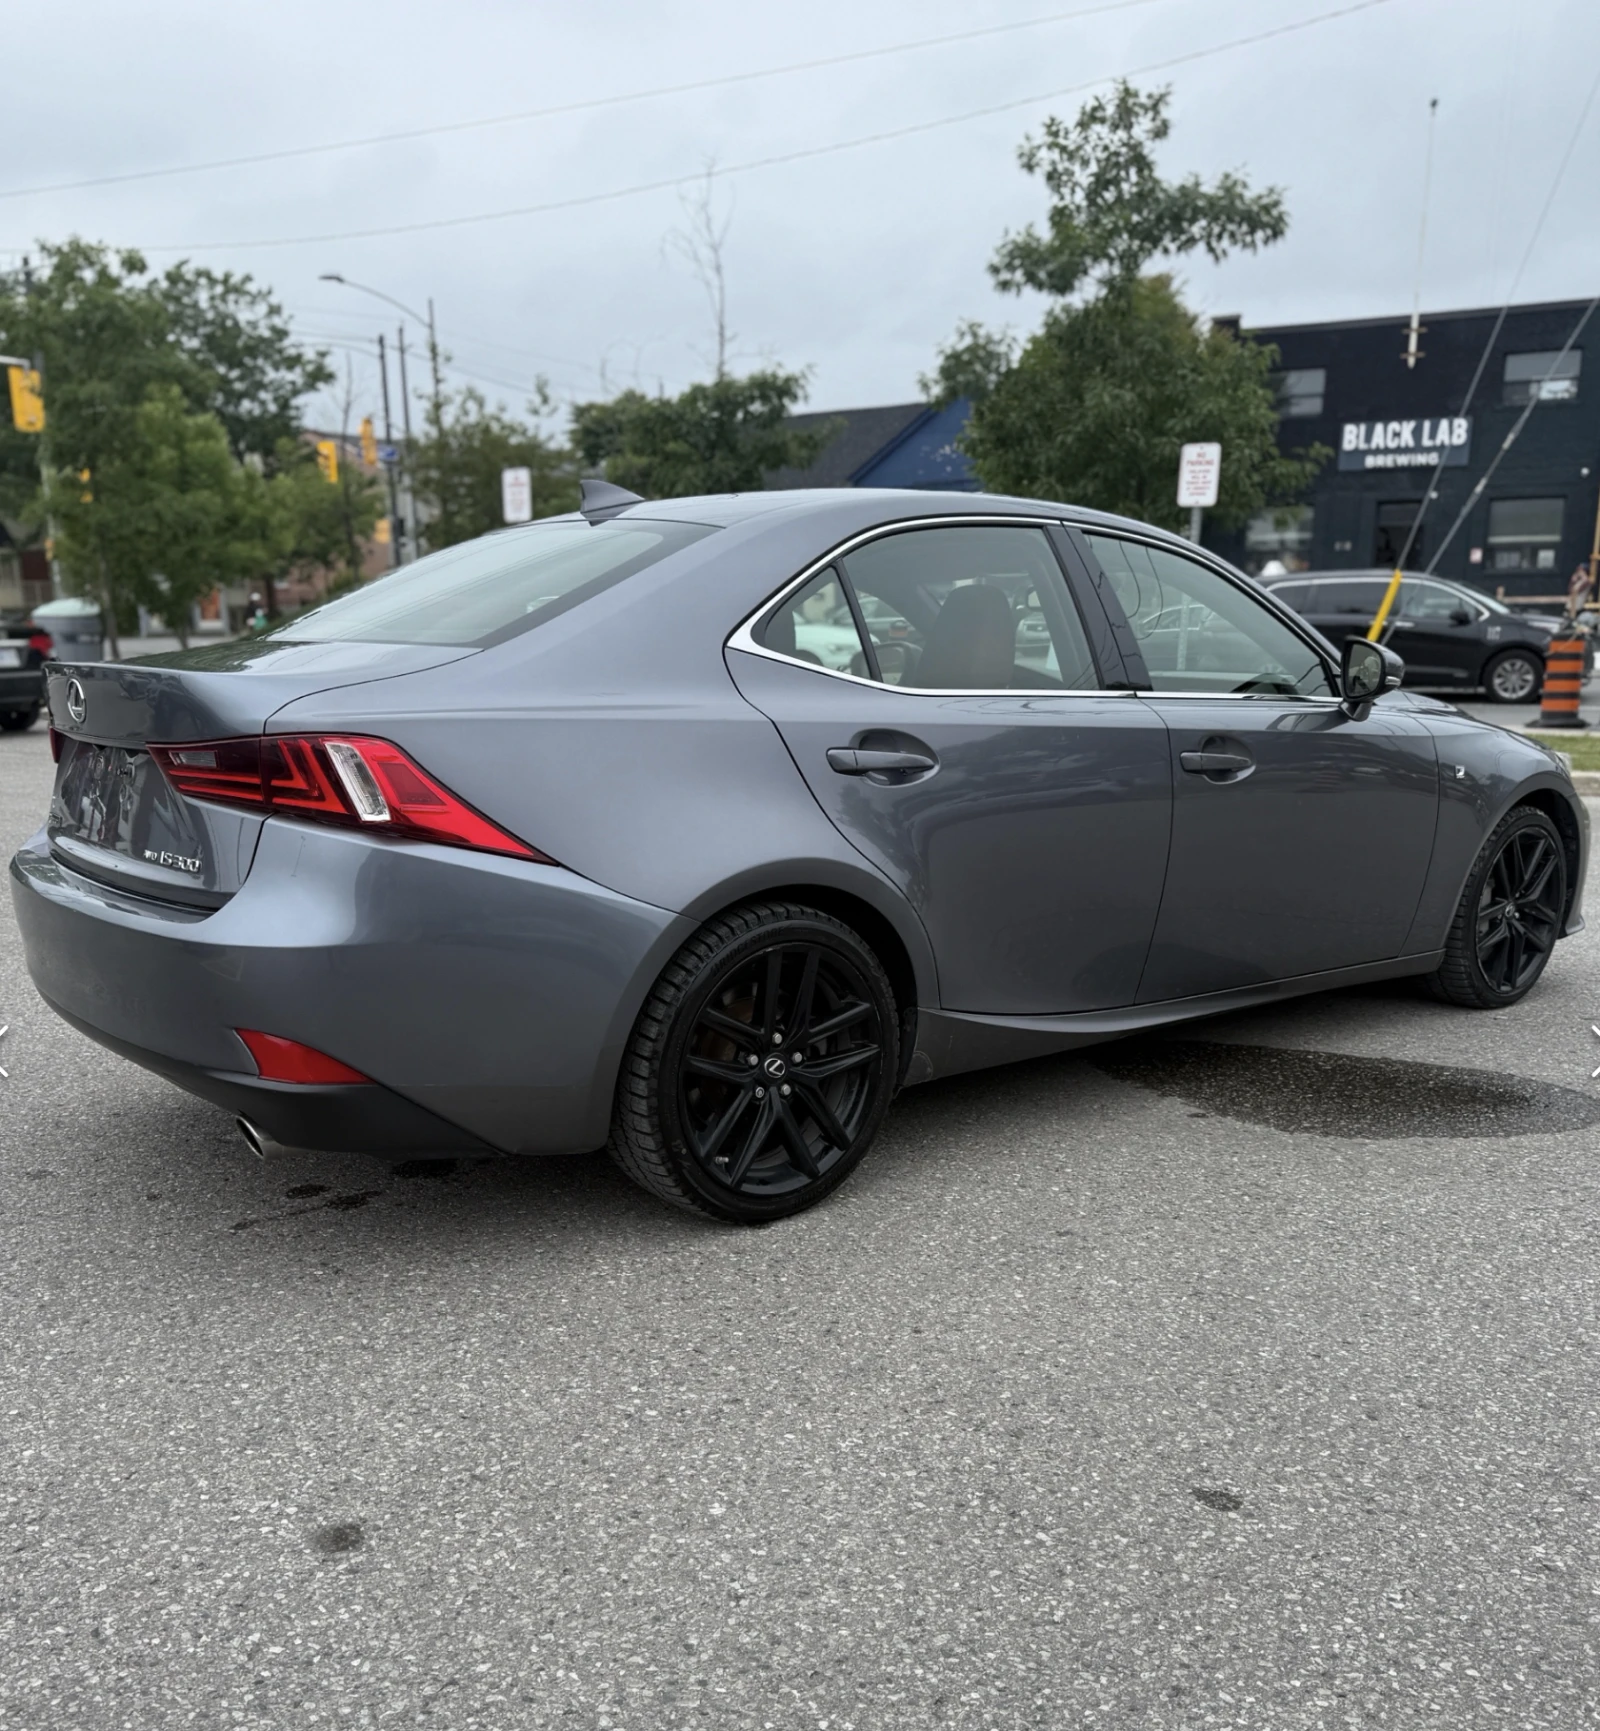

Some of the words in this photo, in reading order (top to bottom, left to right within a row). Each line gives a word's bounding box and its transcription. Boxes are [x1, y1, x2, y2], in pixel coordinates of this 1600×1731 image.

[1342, 420, 1416, 451] BLACK
[1421, 418, 1468, 447] LAB
[1364, 452, 1440, 469] BREWING
